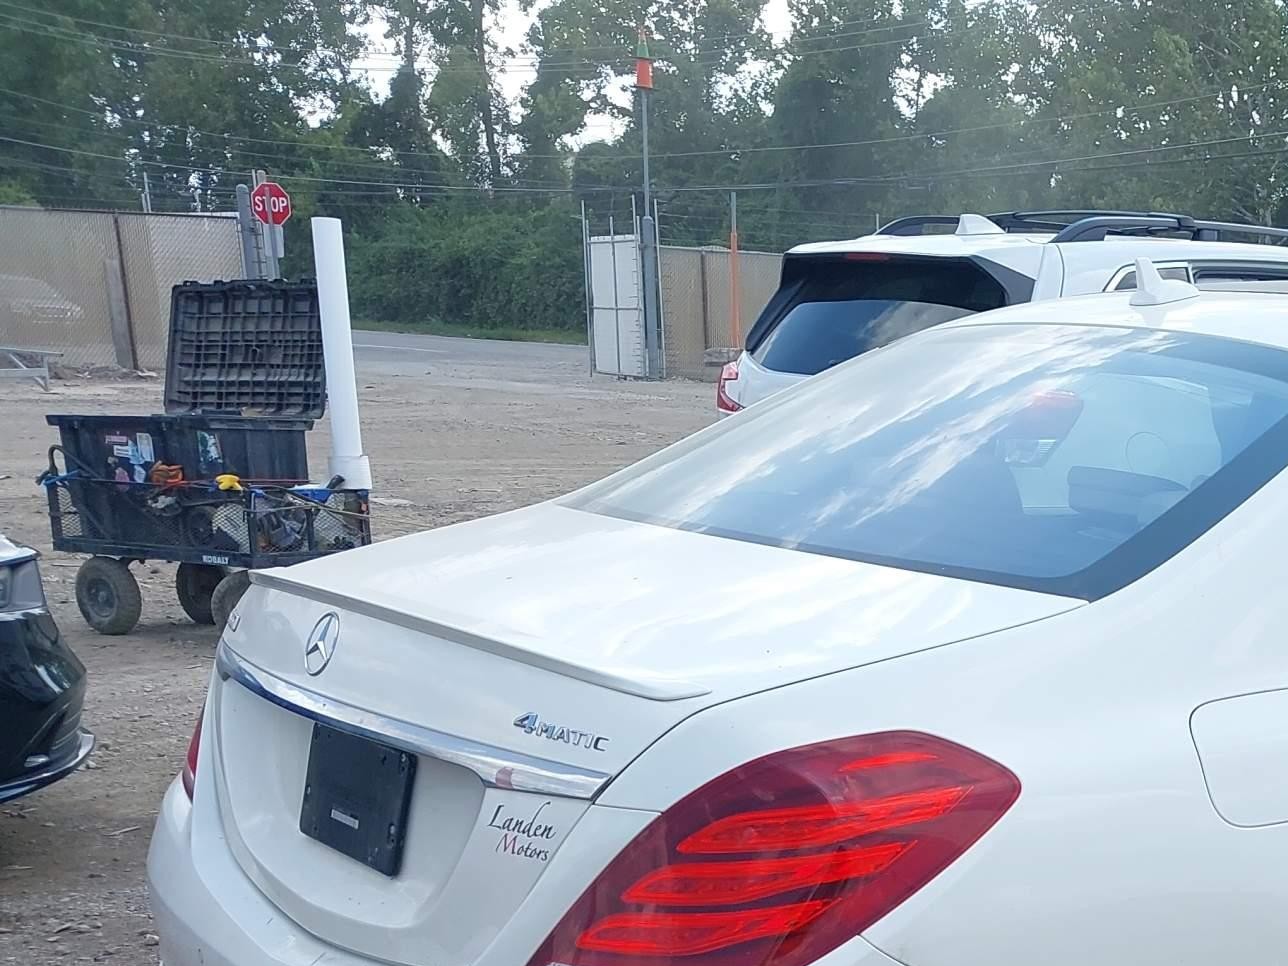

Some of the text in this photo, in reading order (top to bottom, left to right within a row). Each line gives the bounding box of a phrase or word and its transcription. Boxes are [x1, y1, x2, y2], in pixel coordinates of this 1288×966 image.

[254, 196, 288, 213] STOP
[513, 712, 610, 752] 4MATIC
[487, 801, 557, 839] Landen
[496, 833, 549, 862] Motors
